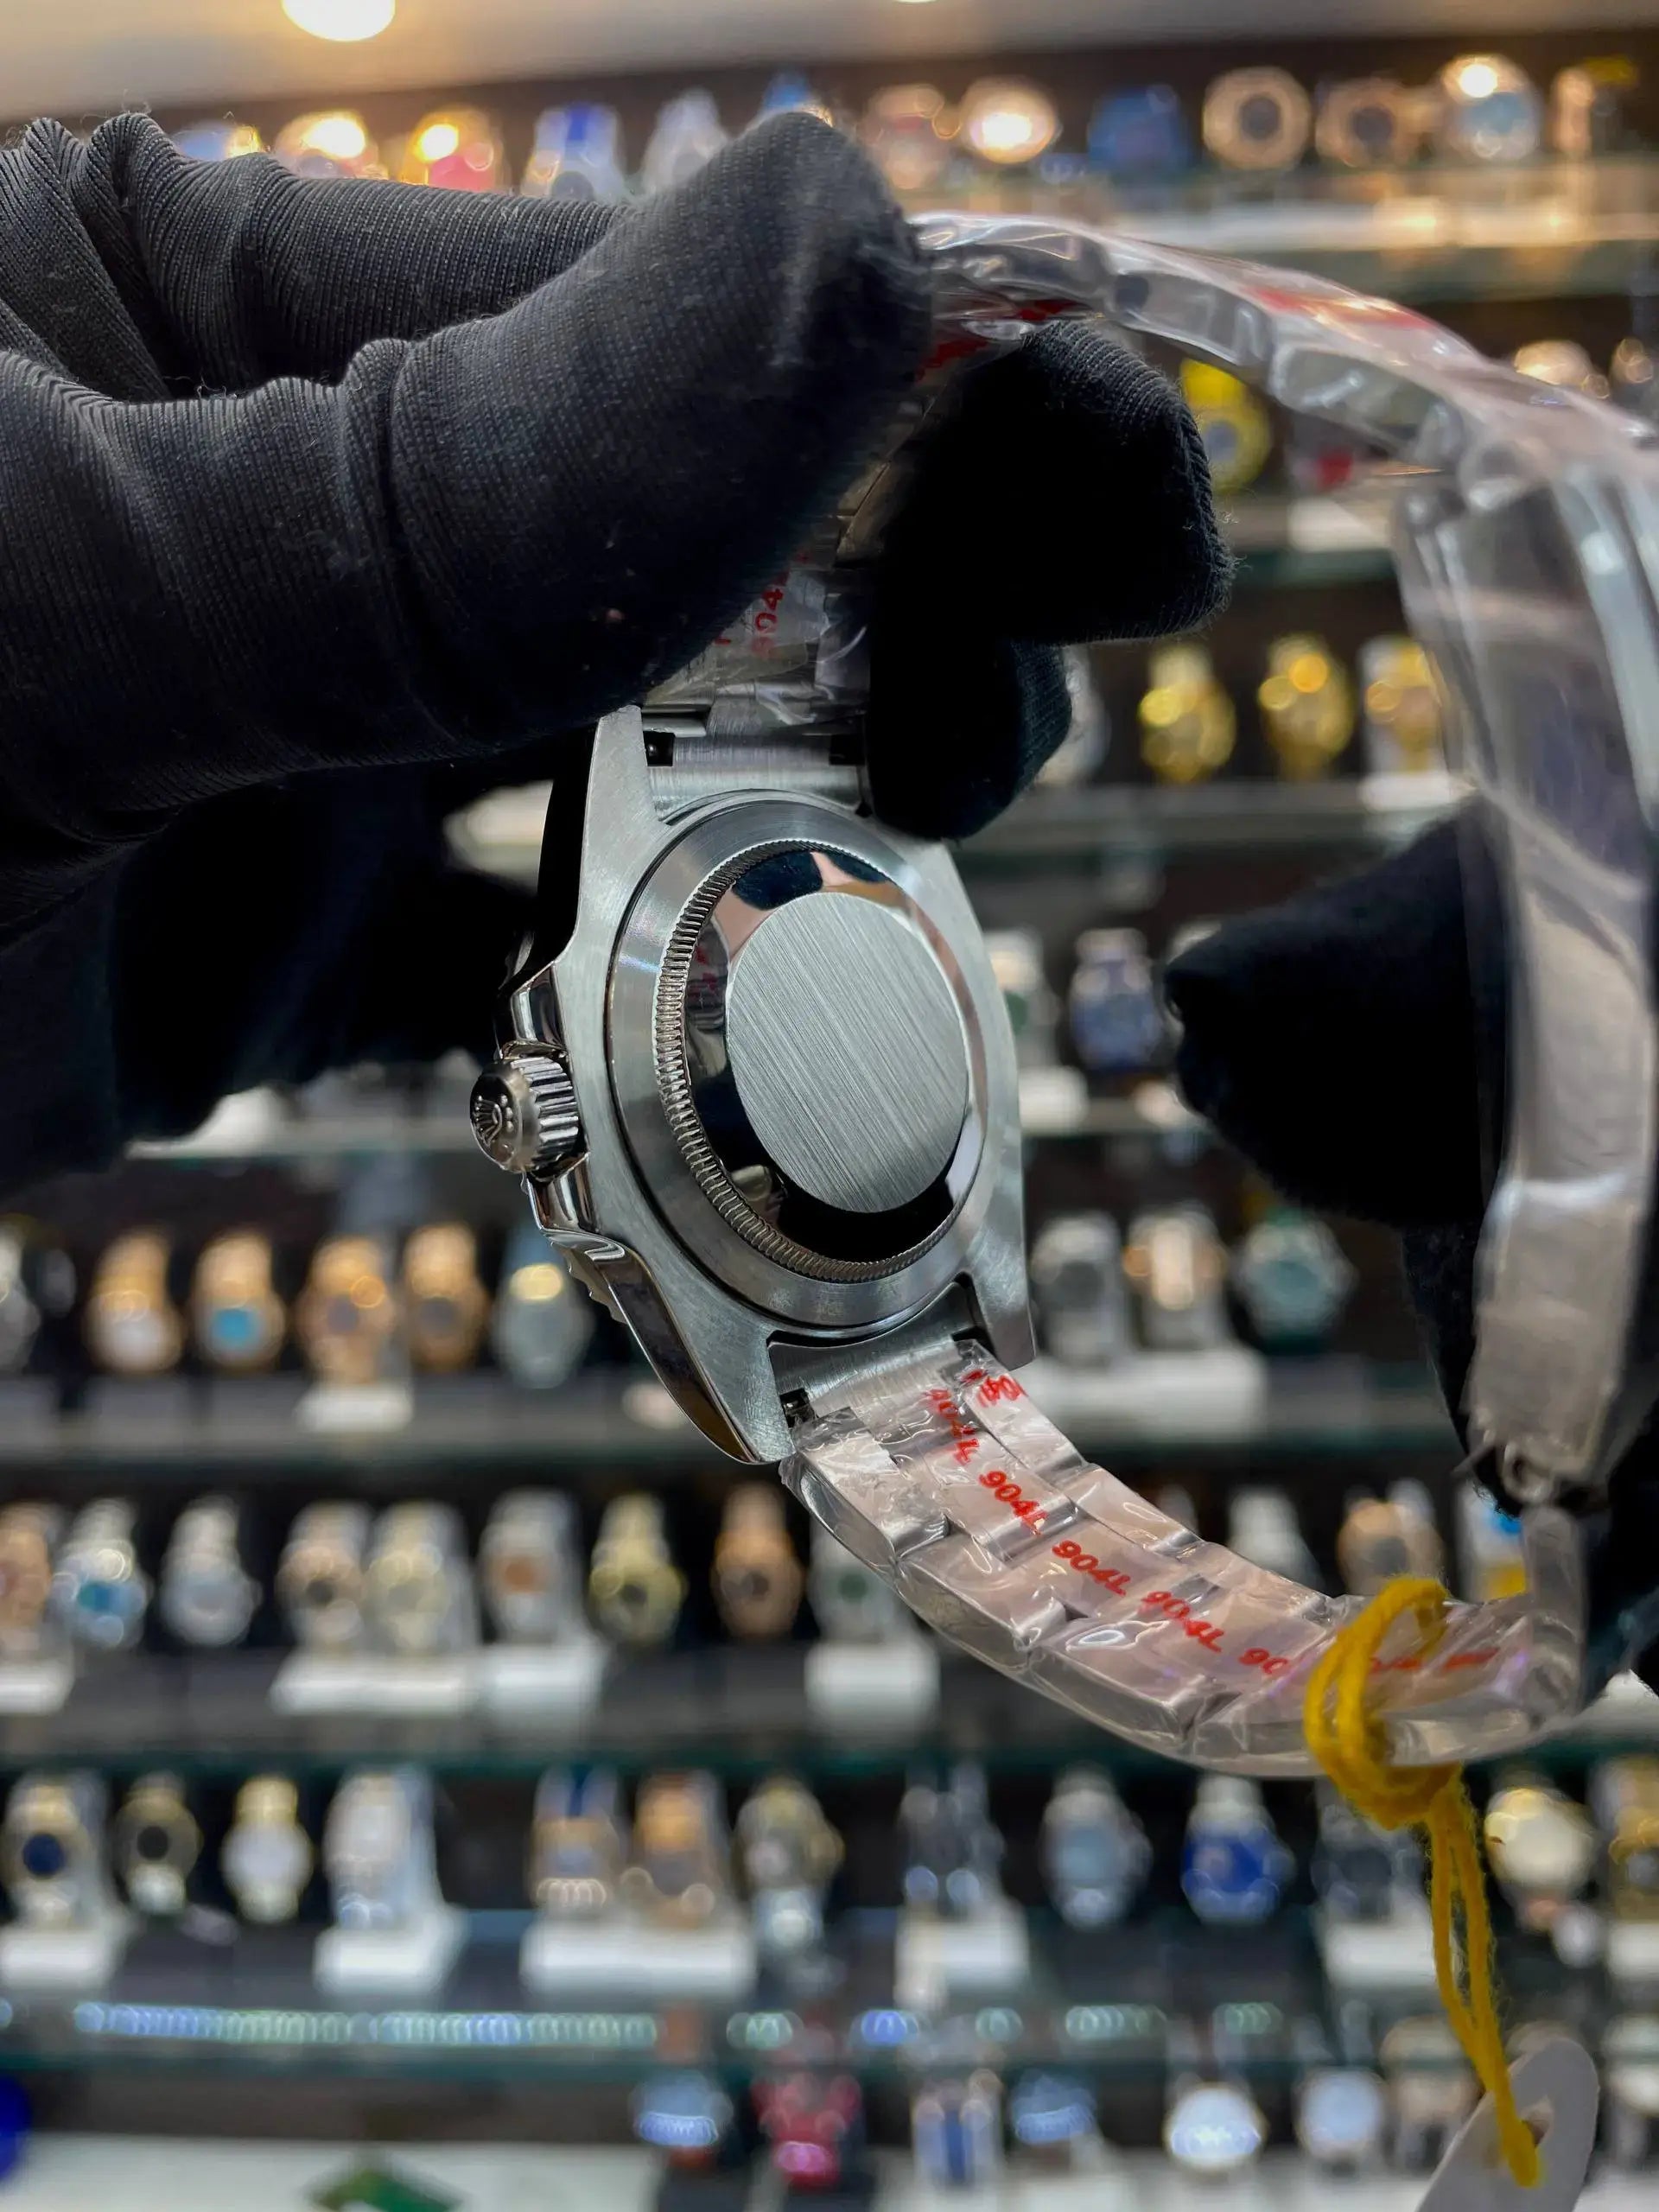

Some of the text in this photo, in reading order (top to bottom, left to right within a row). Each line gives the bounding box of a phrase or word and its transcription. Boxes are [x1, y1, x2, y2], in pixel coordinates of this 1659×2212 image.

[978, 1471, 1048, 1535] 904L
[1052, 1541, 1131, 1596] 904L
[1141, 1591, 1225, 1653] 904L
